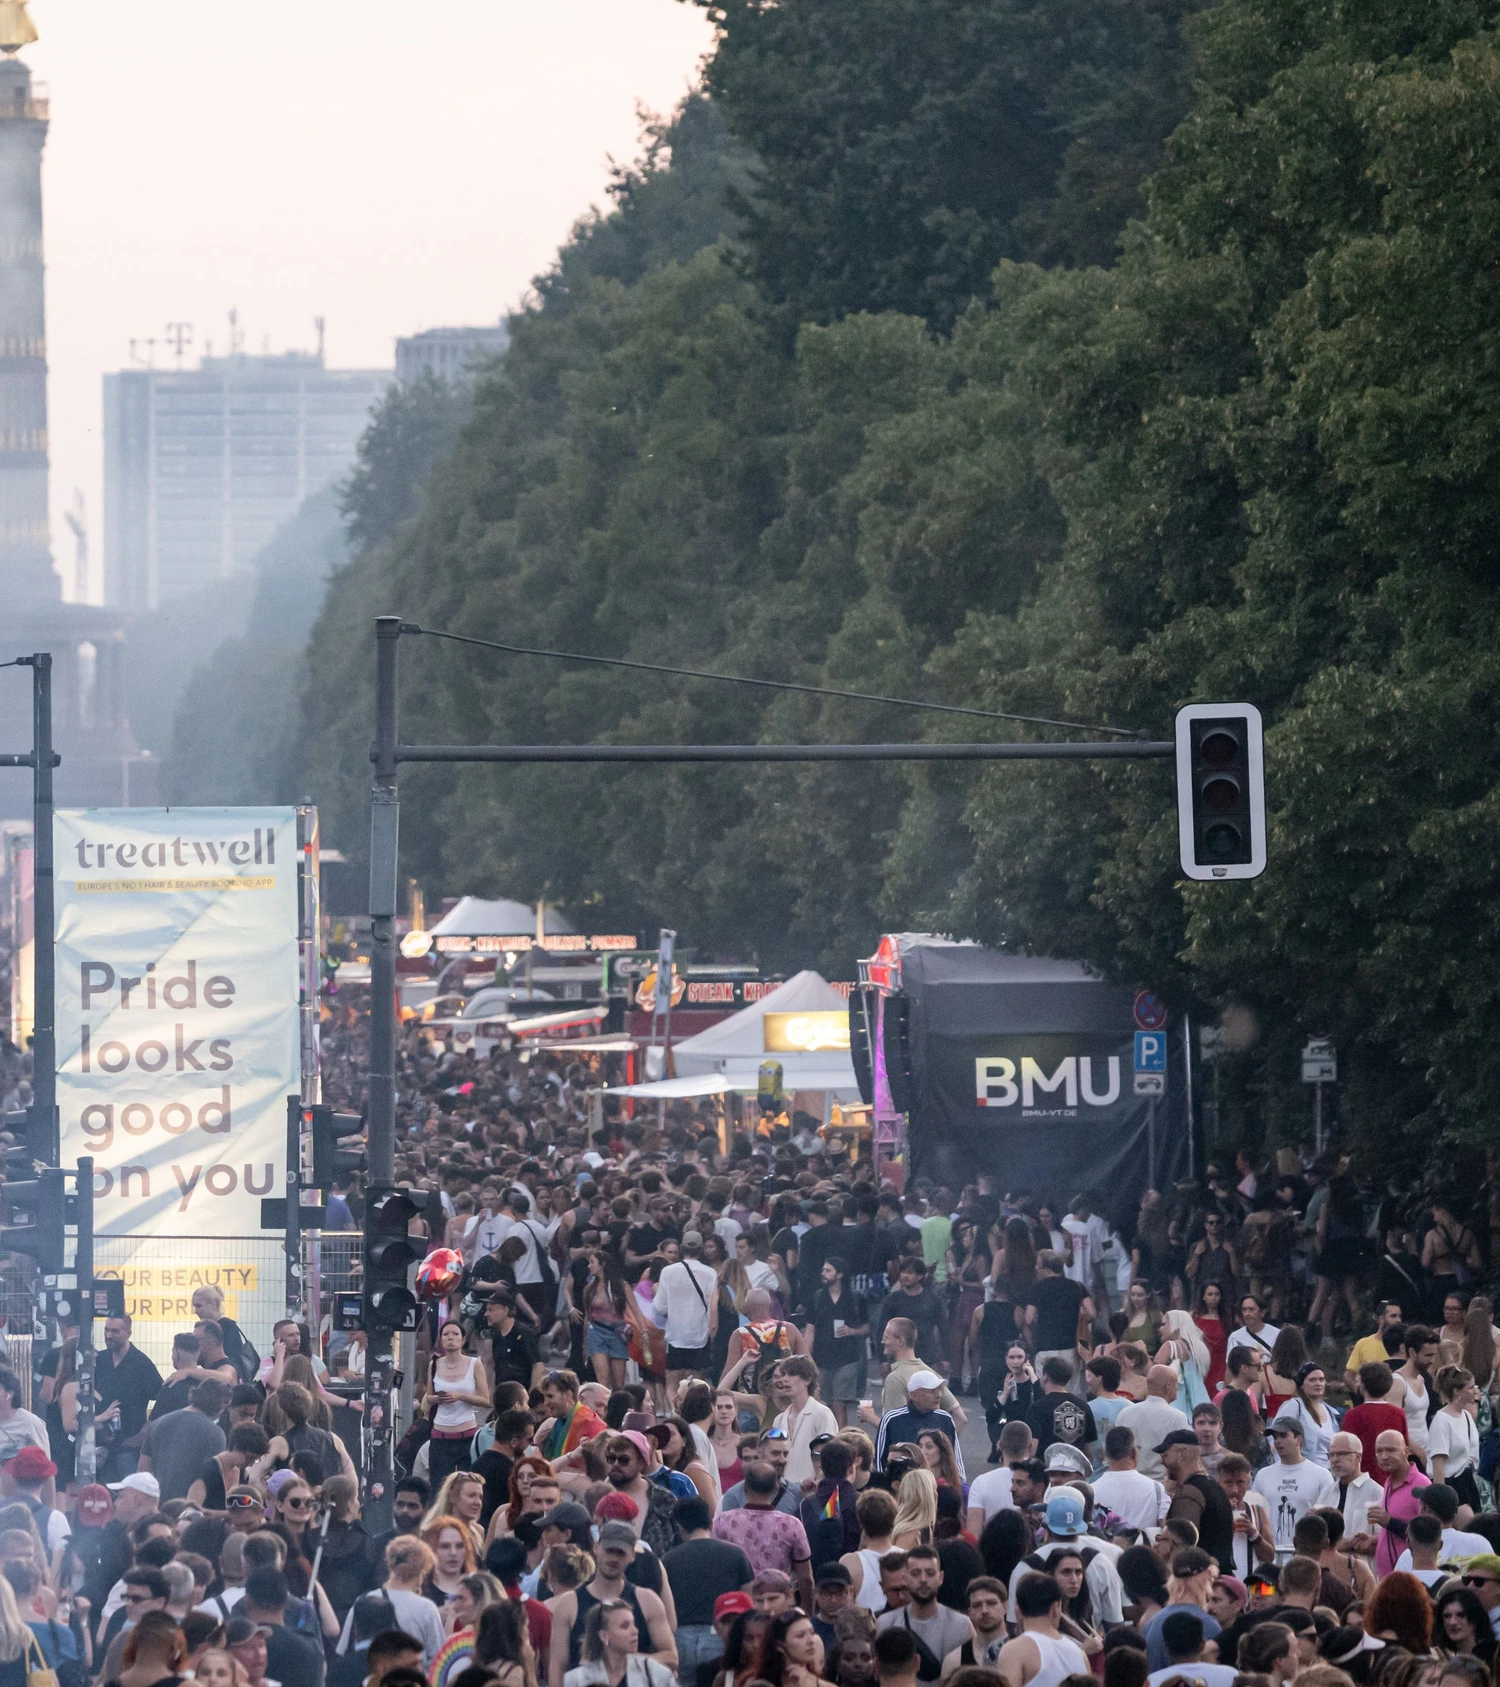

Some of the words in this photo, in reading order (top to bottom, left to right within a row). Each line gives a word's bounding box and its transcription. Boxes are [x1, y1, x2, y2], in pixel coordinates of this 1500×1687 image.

[74, 828, 275, 869] treatwell
[78, 882, 121, 891] EUROPE'S
[122, 881, 138, 890] NO
[144, 881, 165, 889] HAIR
[167, 880, 174, 889] &
[175, 880, 209, 889] BEAUTY
[255, 878, 273, 887] APP
[81, 959, 236, 1010] Pride
[688, 982, 734, 1003] STEAK
[743, 982, 783, 1003] KRA
[81, 1023, 234, 1073] looks
[1141, 1036, 1159, 1066] P
[975, 1056, 1121, 1107] BMU
[80, 1084, 232, 1152] good
[1022, 1109, 1078, 1117] BMU-VT.DE
[93, 1164, 151, 1198] on
[171, 1163, 274, 1213] you
[161, 1268, 252, 1287] BEAUTY
[124, 1299, 153, 1316] UR
